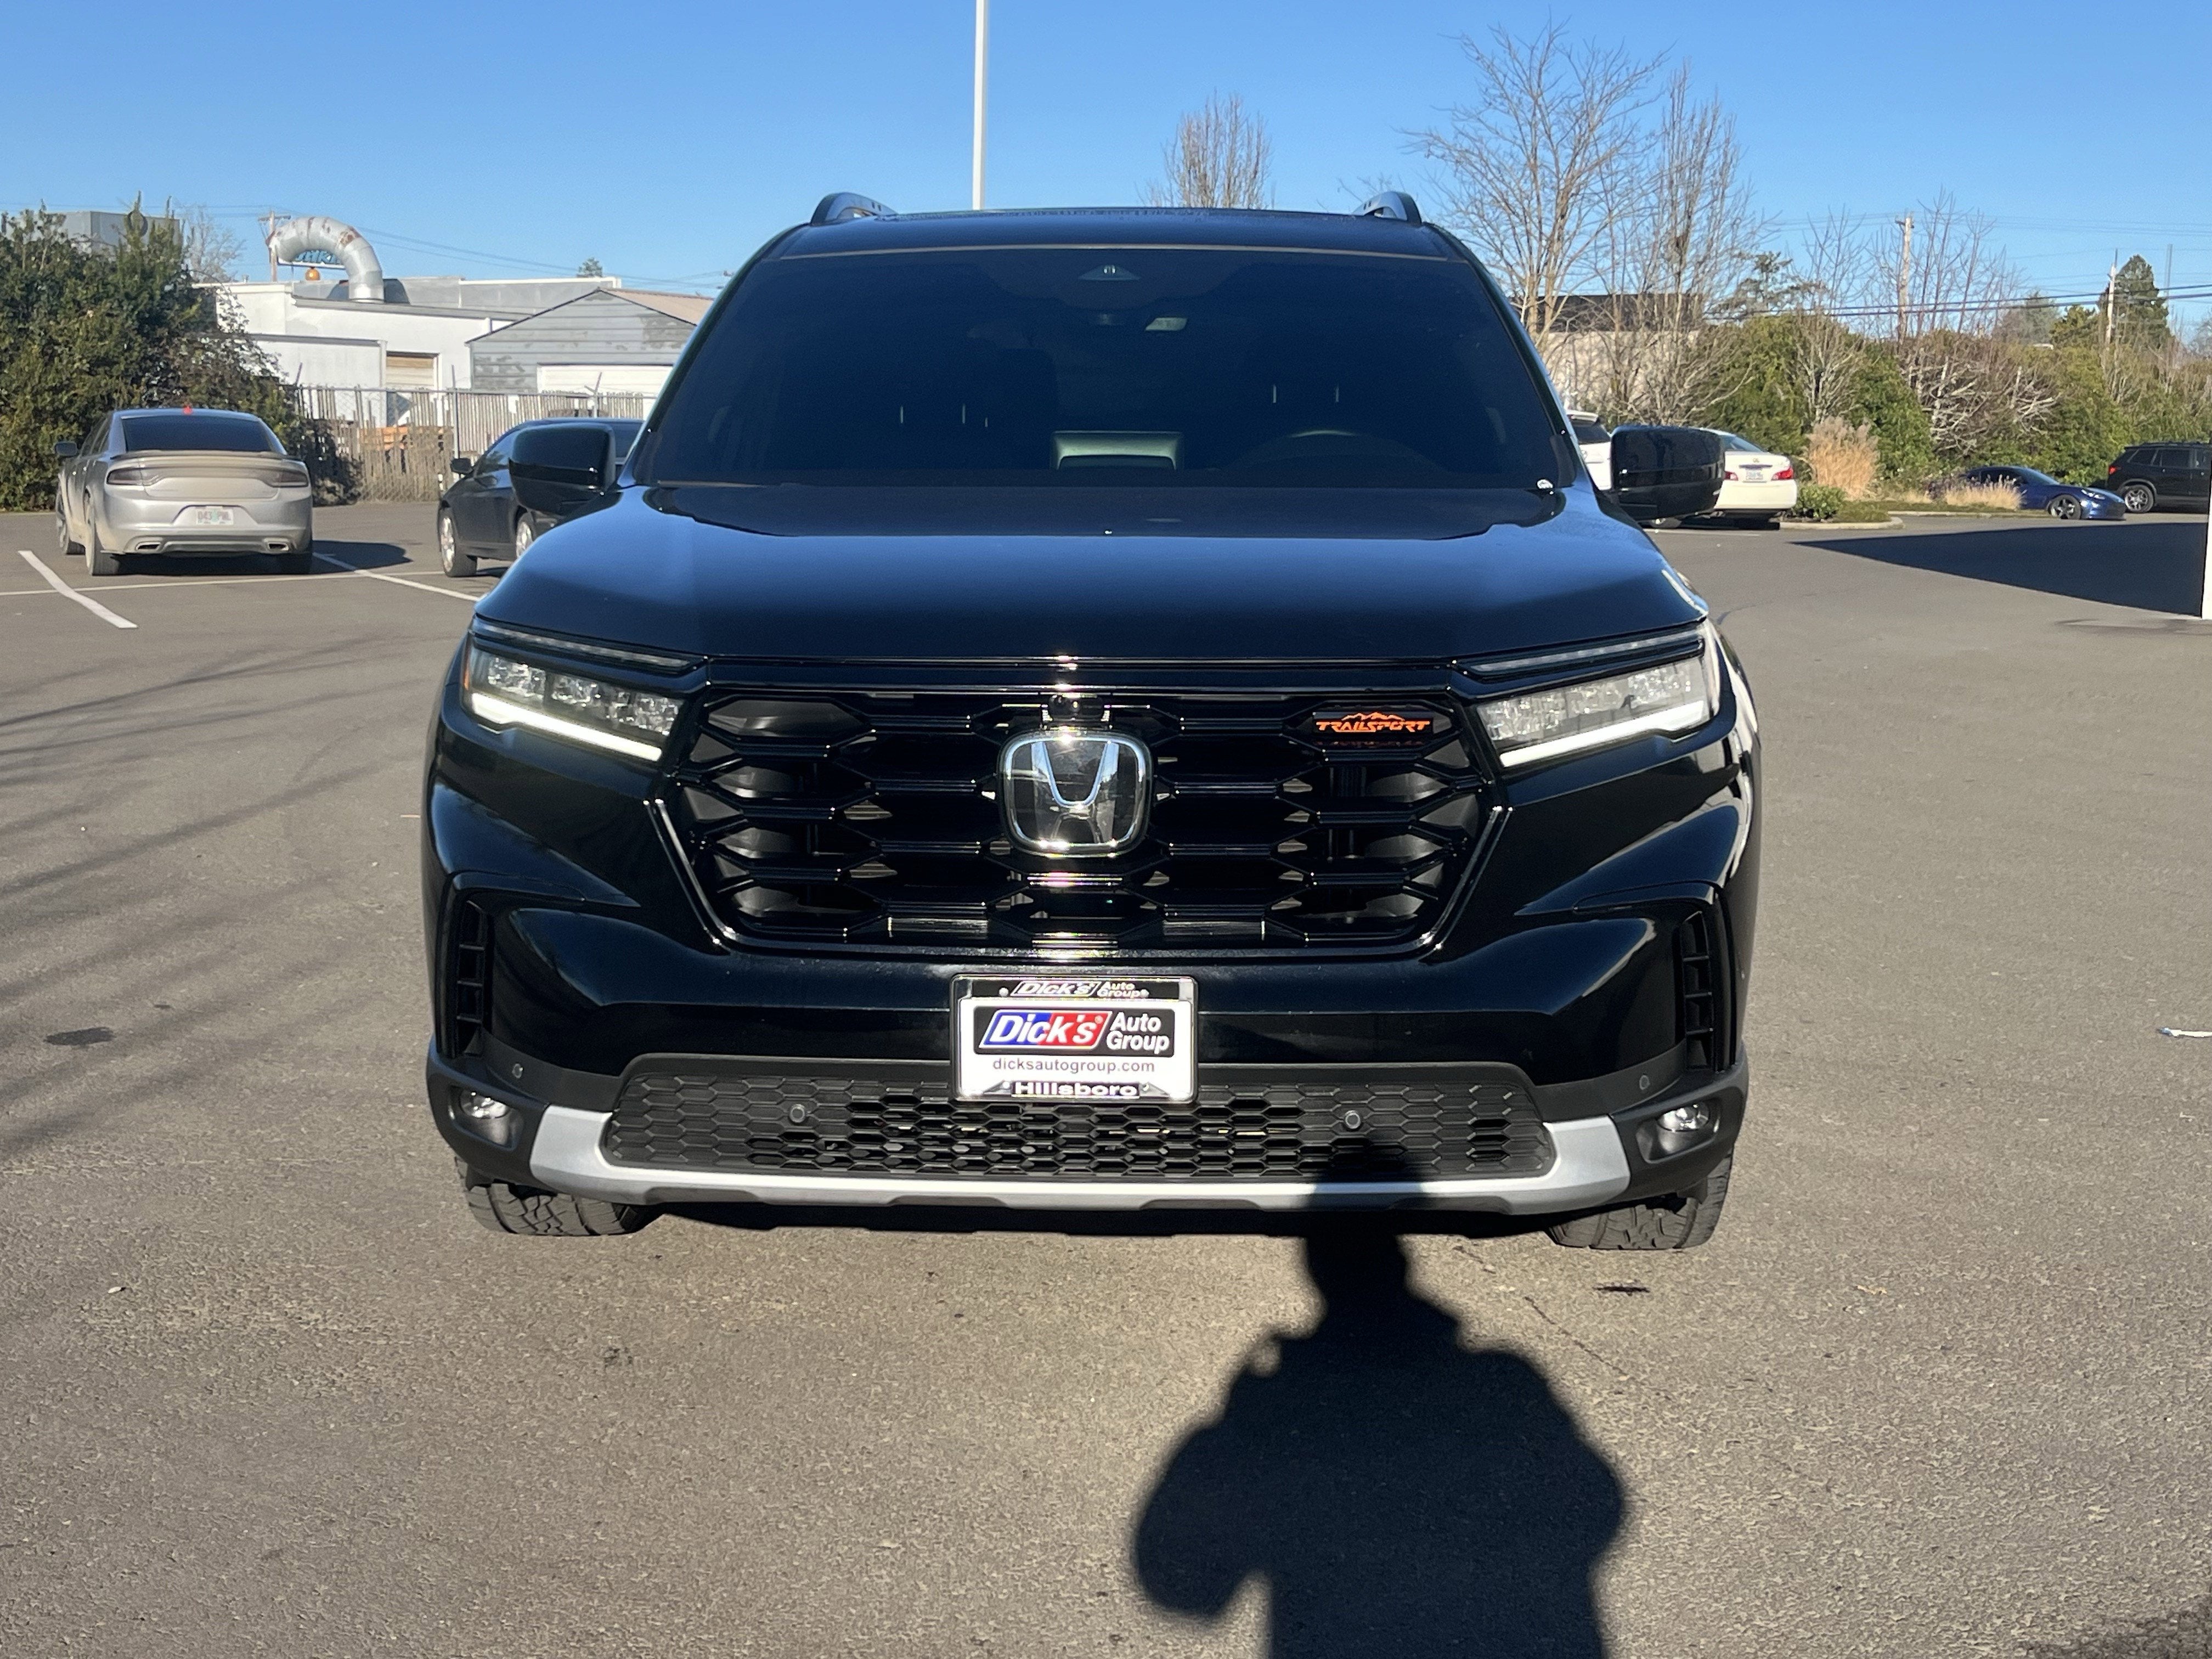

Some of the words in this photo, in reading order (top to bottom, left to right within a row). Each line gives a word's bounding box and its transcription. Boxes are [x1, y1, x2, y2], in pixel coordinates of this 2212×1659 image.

[1316, 721, 1430, 732] TRAILSPORT
[1097, 988, 1141, 998] Group
[1101, 981, 1135, 990] Auto
[990, 1013, 1098, 1043] Dick's
[1109, 1012, 1161, 1032] Auto
[1106, 1030, 1170, 1054] Group
[992, 1058, 1155, 1074] dicksautogroup.com
[1015, 1081, 1137, 1096] Hillsboro
